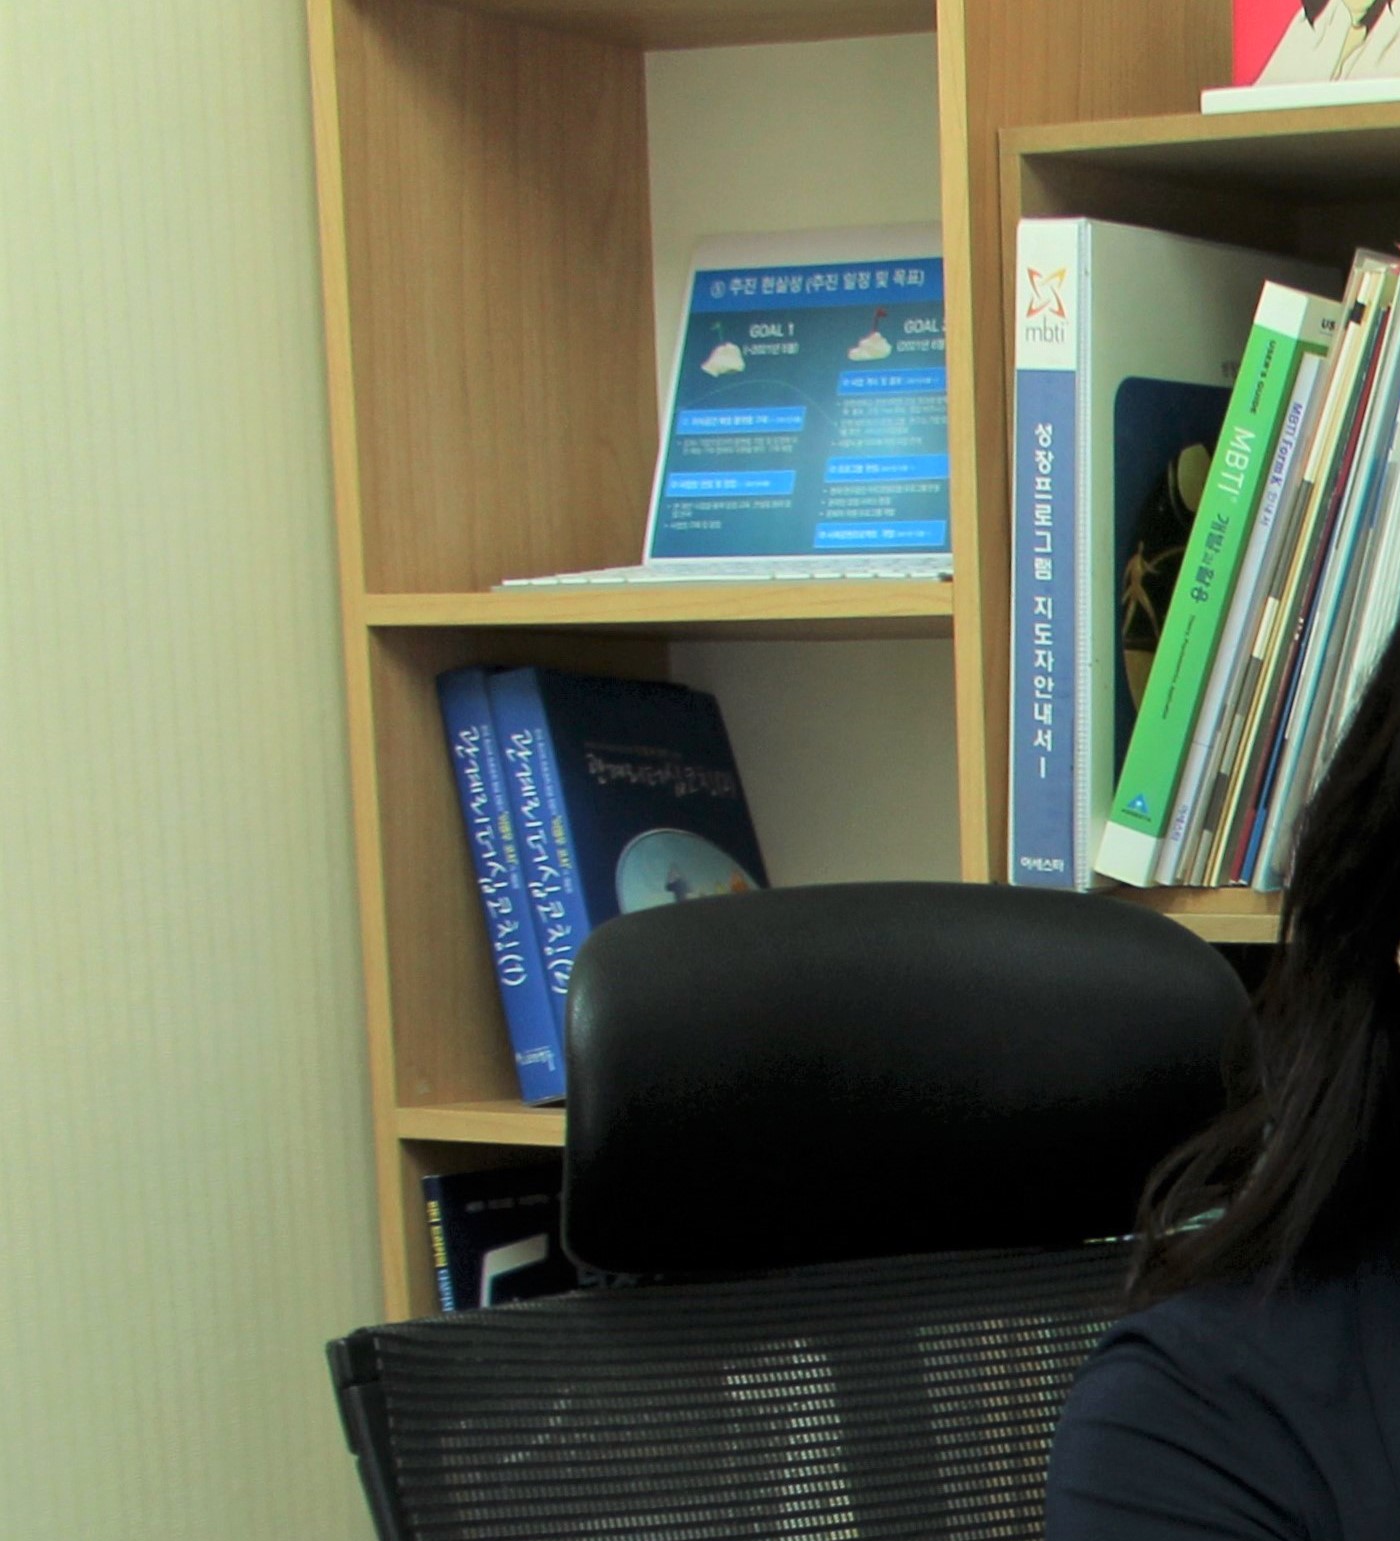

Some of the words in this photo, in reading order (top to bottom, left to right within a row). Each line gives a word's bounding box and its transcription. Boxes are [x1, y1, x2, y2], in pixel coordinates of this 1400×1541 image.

[749, 323, 784, 339] GOAL
[904, 318, 939, 333] GOAL
[1025, 315, 1066, 345] mbti
[1250, 380, 1265, 415] GUIDE
[1285, 402, 1304, 435] MBTI
[1273, 438, 1294, 473] Form
[1033, 422, 1055, 580] 성장프로그램
[1033, 596, 1055, 752] 지도자안내서
